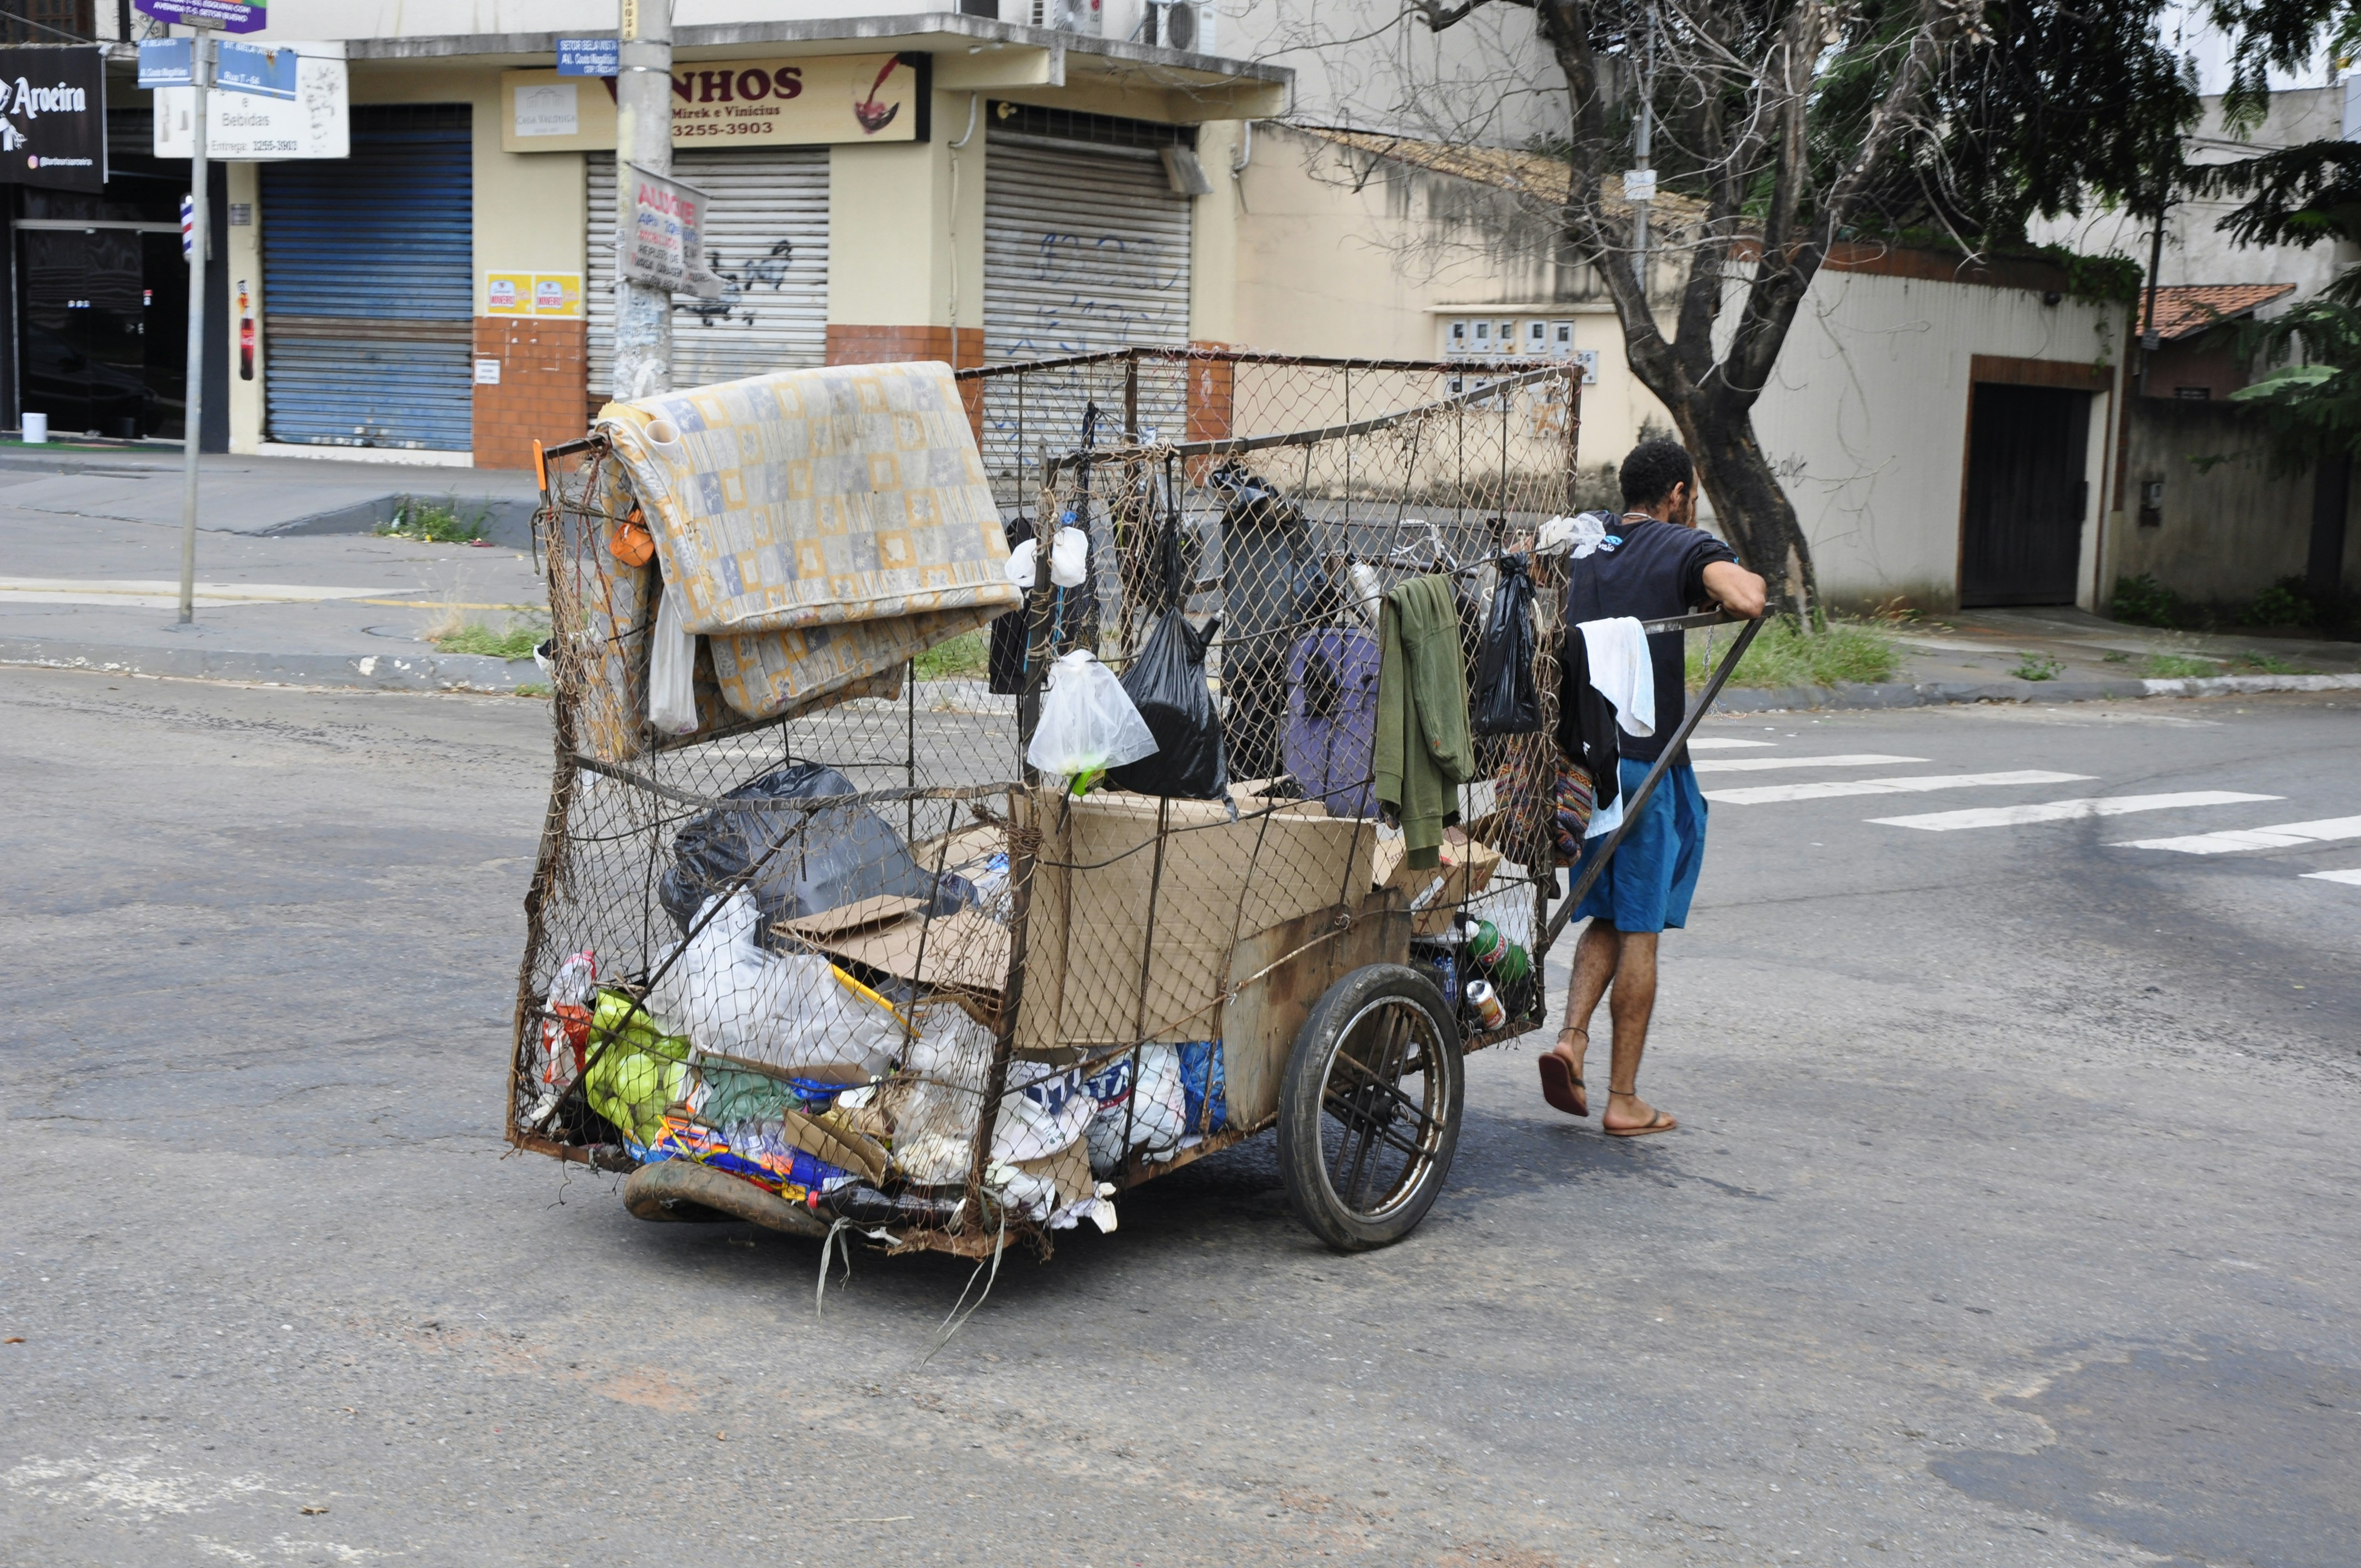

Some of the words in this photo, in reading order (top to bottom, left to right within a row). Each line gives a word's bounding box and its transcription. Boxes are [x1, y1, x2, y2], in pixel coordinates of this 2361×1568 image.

[9, 77, 86, 119] Aroeira
[222, 112, 270, 127] Bebidas
[672, 107, 710, 119] Mirek
[714, 110, 722, 118] e
[672, 121, 773, 137] 3255-3903
